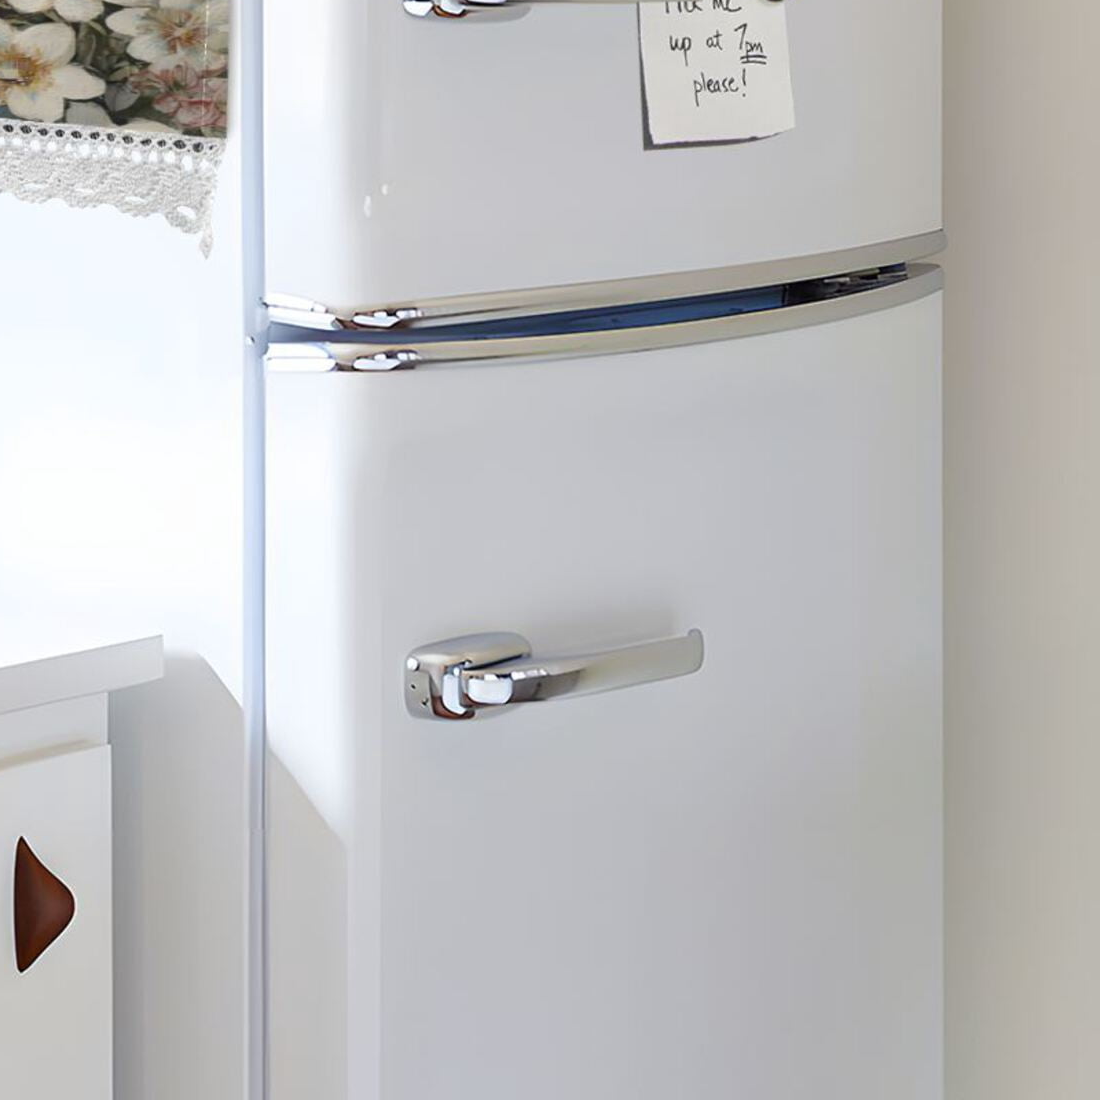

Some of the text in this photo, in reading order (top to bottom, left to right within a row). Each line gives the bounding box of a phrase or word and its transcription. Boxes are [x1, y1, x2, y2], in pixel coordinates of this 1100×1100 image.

[669, 34, 692, 67] up
[705, 29, 723, 51] at
[693, 68, 747, 107] please!
